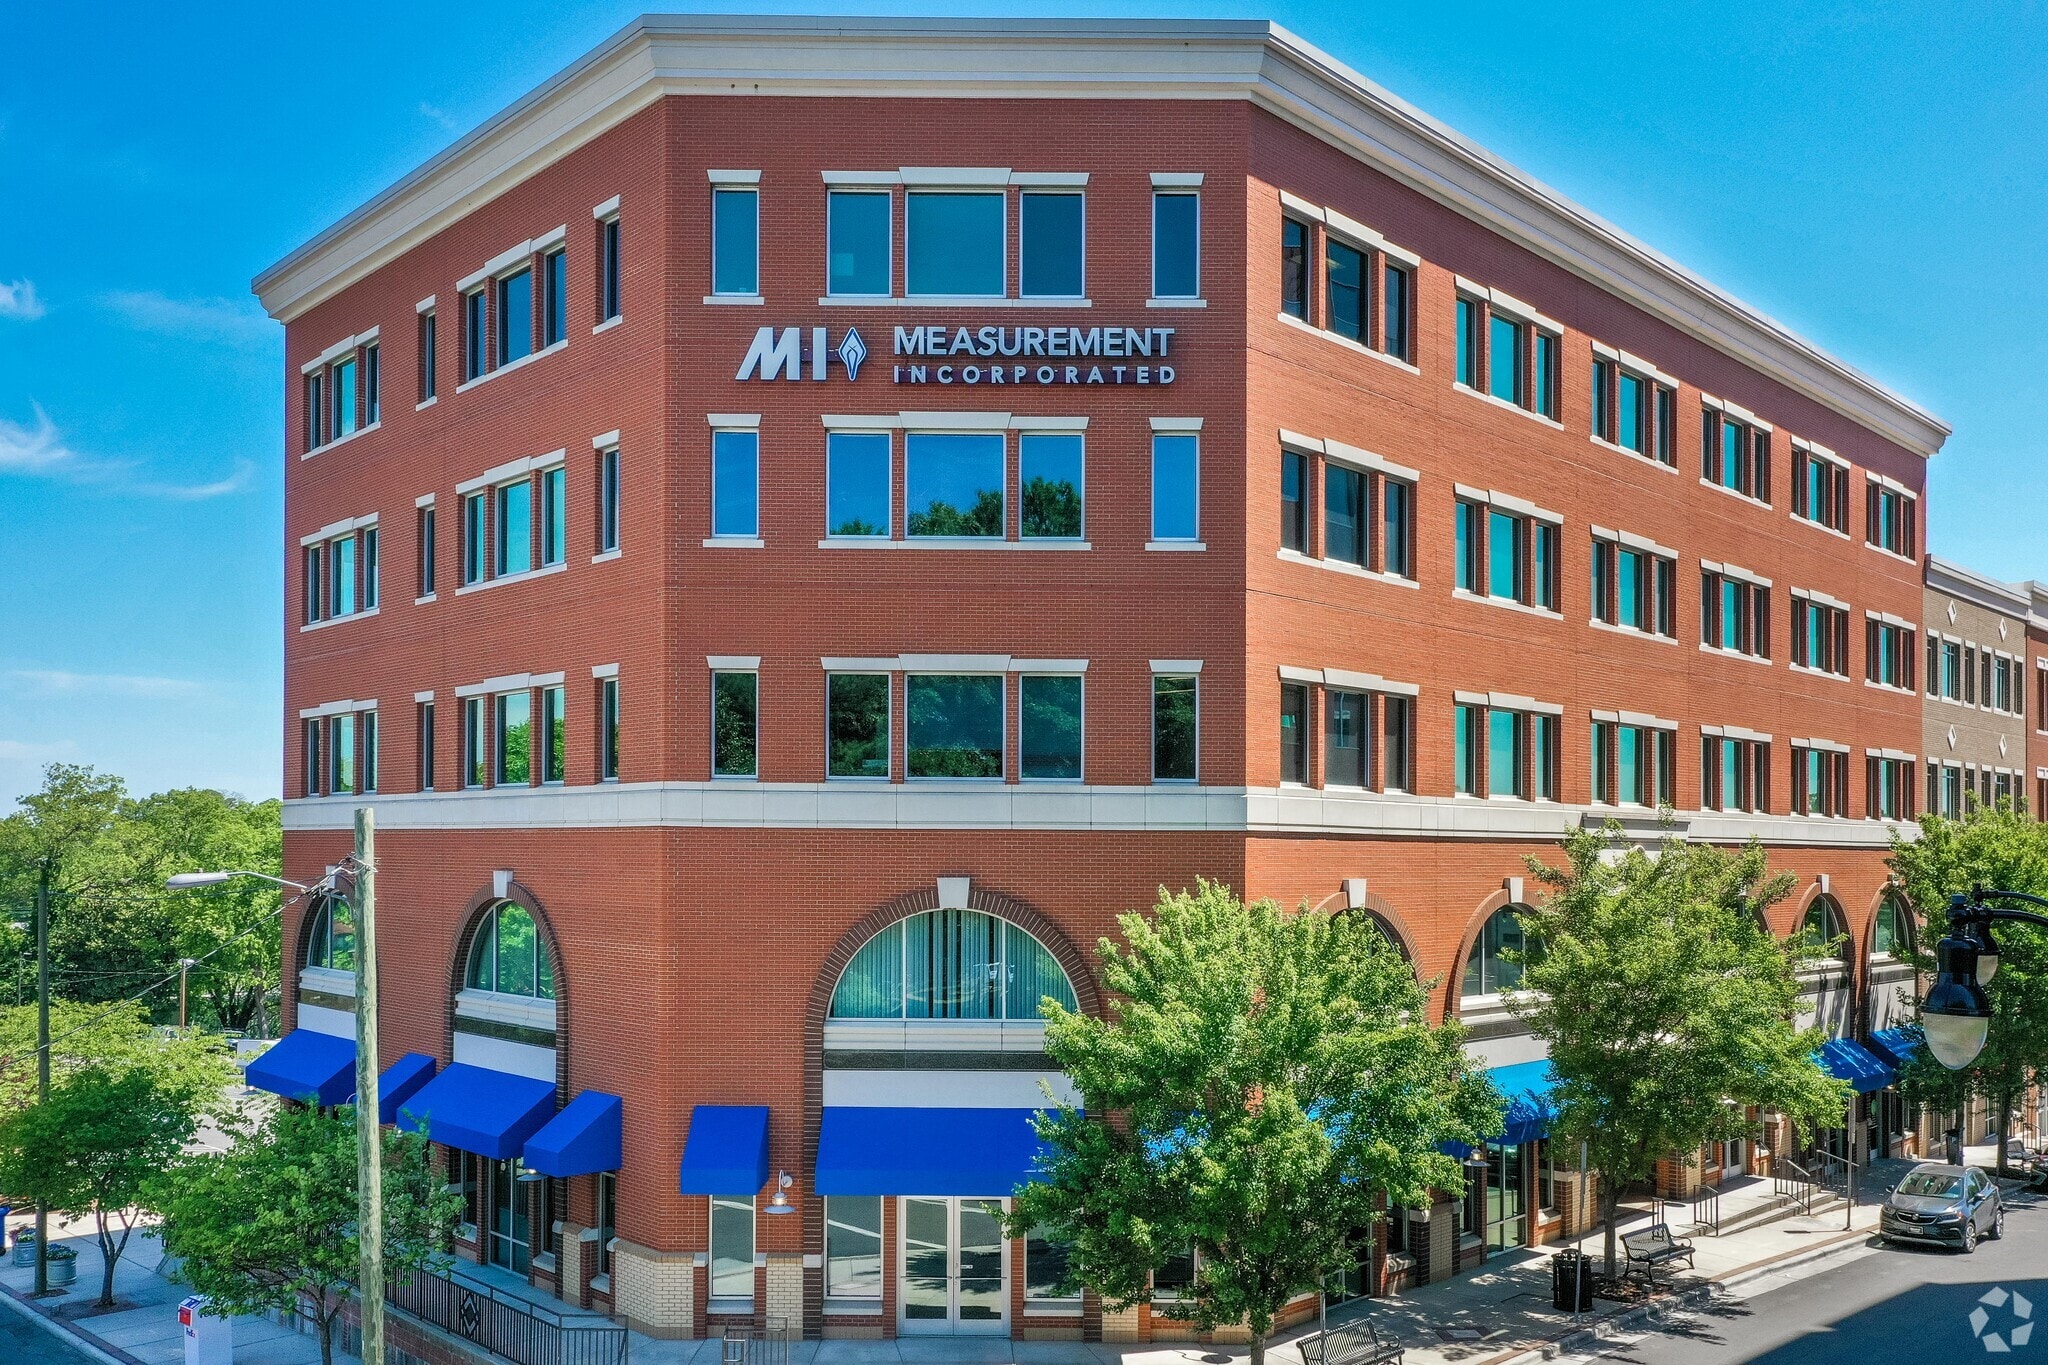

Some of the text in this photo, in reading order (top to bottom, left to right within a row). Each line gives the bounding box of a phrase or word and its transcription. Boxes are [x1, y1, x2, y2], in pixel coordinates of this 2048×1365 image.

[735, 326, 827, 381] MI
[893, 326, 1175, 356] MEASUREMENT
[893, 365, 1176, 384] INCORPORATED
